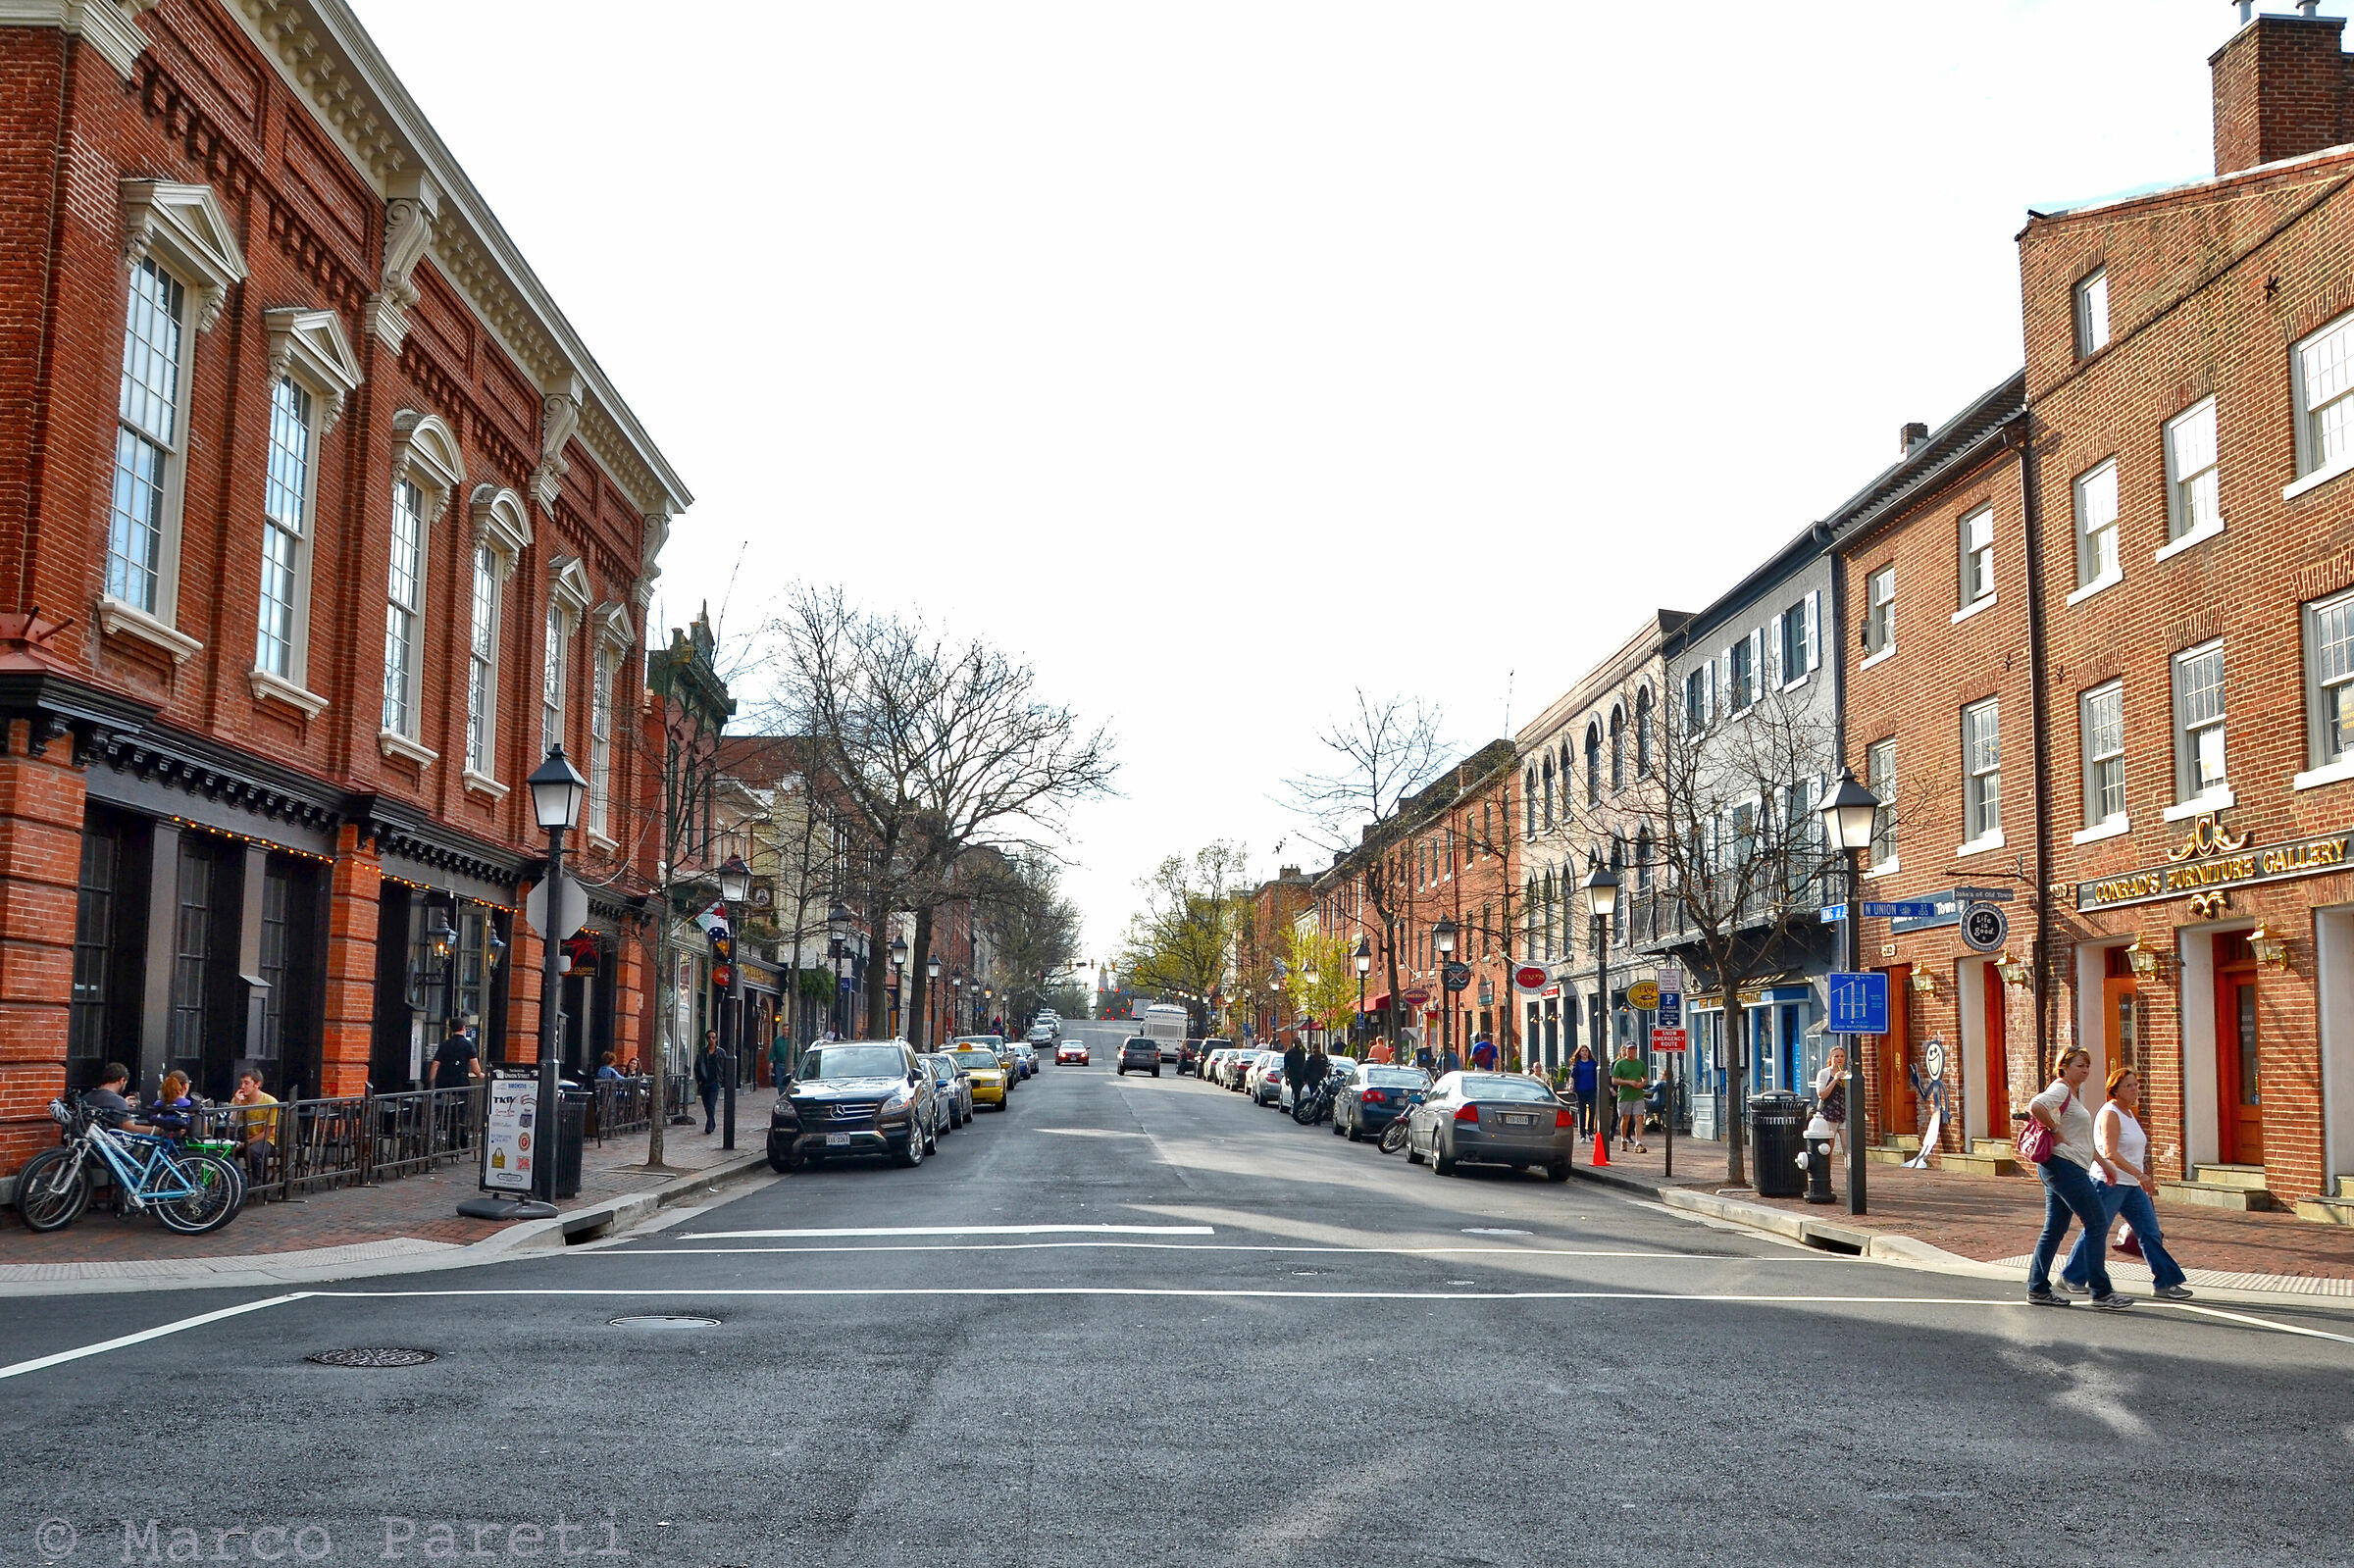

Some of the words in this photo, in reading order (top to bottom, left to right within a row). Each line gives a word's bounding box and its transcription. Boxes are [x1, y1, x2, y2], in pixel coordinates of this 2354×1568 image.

[2095, 872, 2162, 903] CONRAD'S
[2166, 855, 2256, 891] FURNITURE
[2263, 837, 2348, 875] GALLERY
[1866, 904, 1870, 915] N
[1873, 904, 1897, 915] UNION
[1936, 902, 1956, 915] Town
[1976, 914, 1992, 924] Life
[1666, 994, 1673, 1004] P
